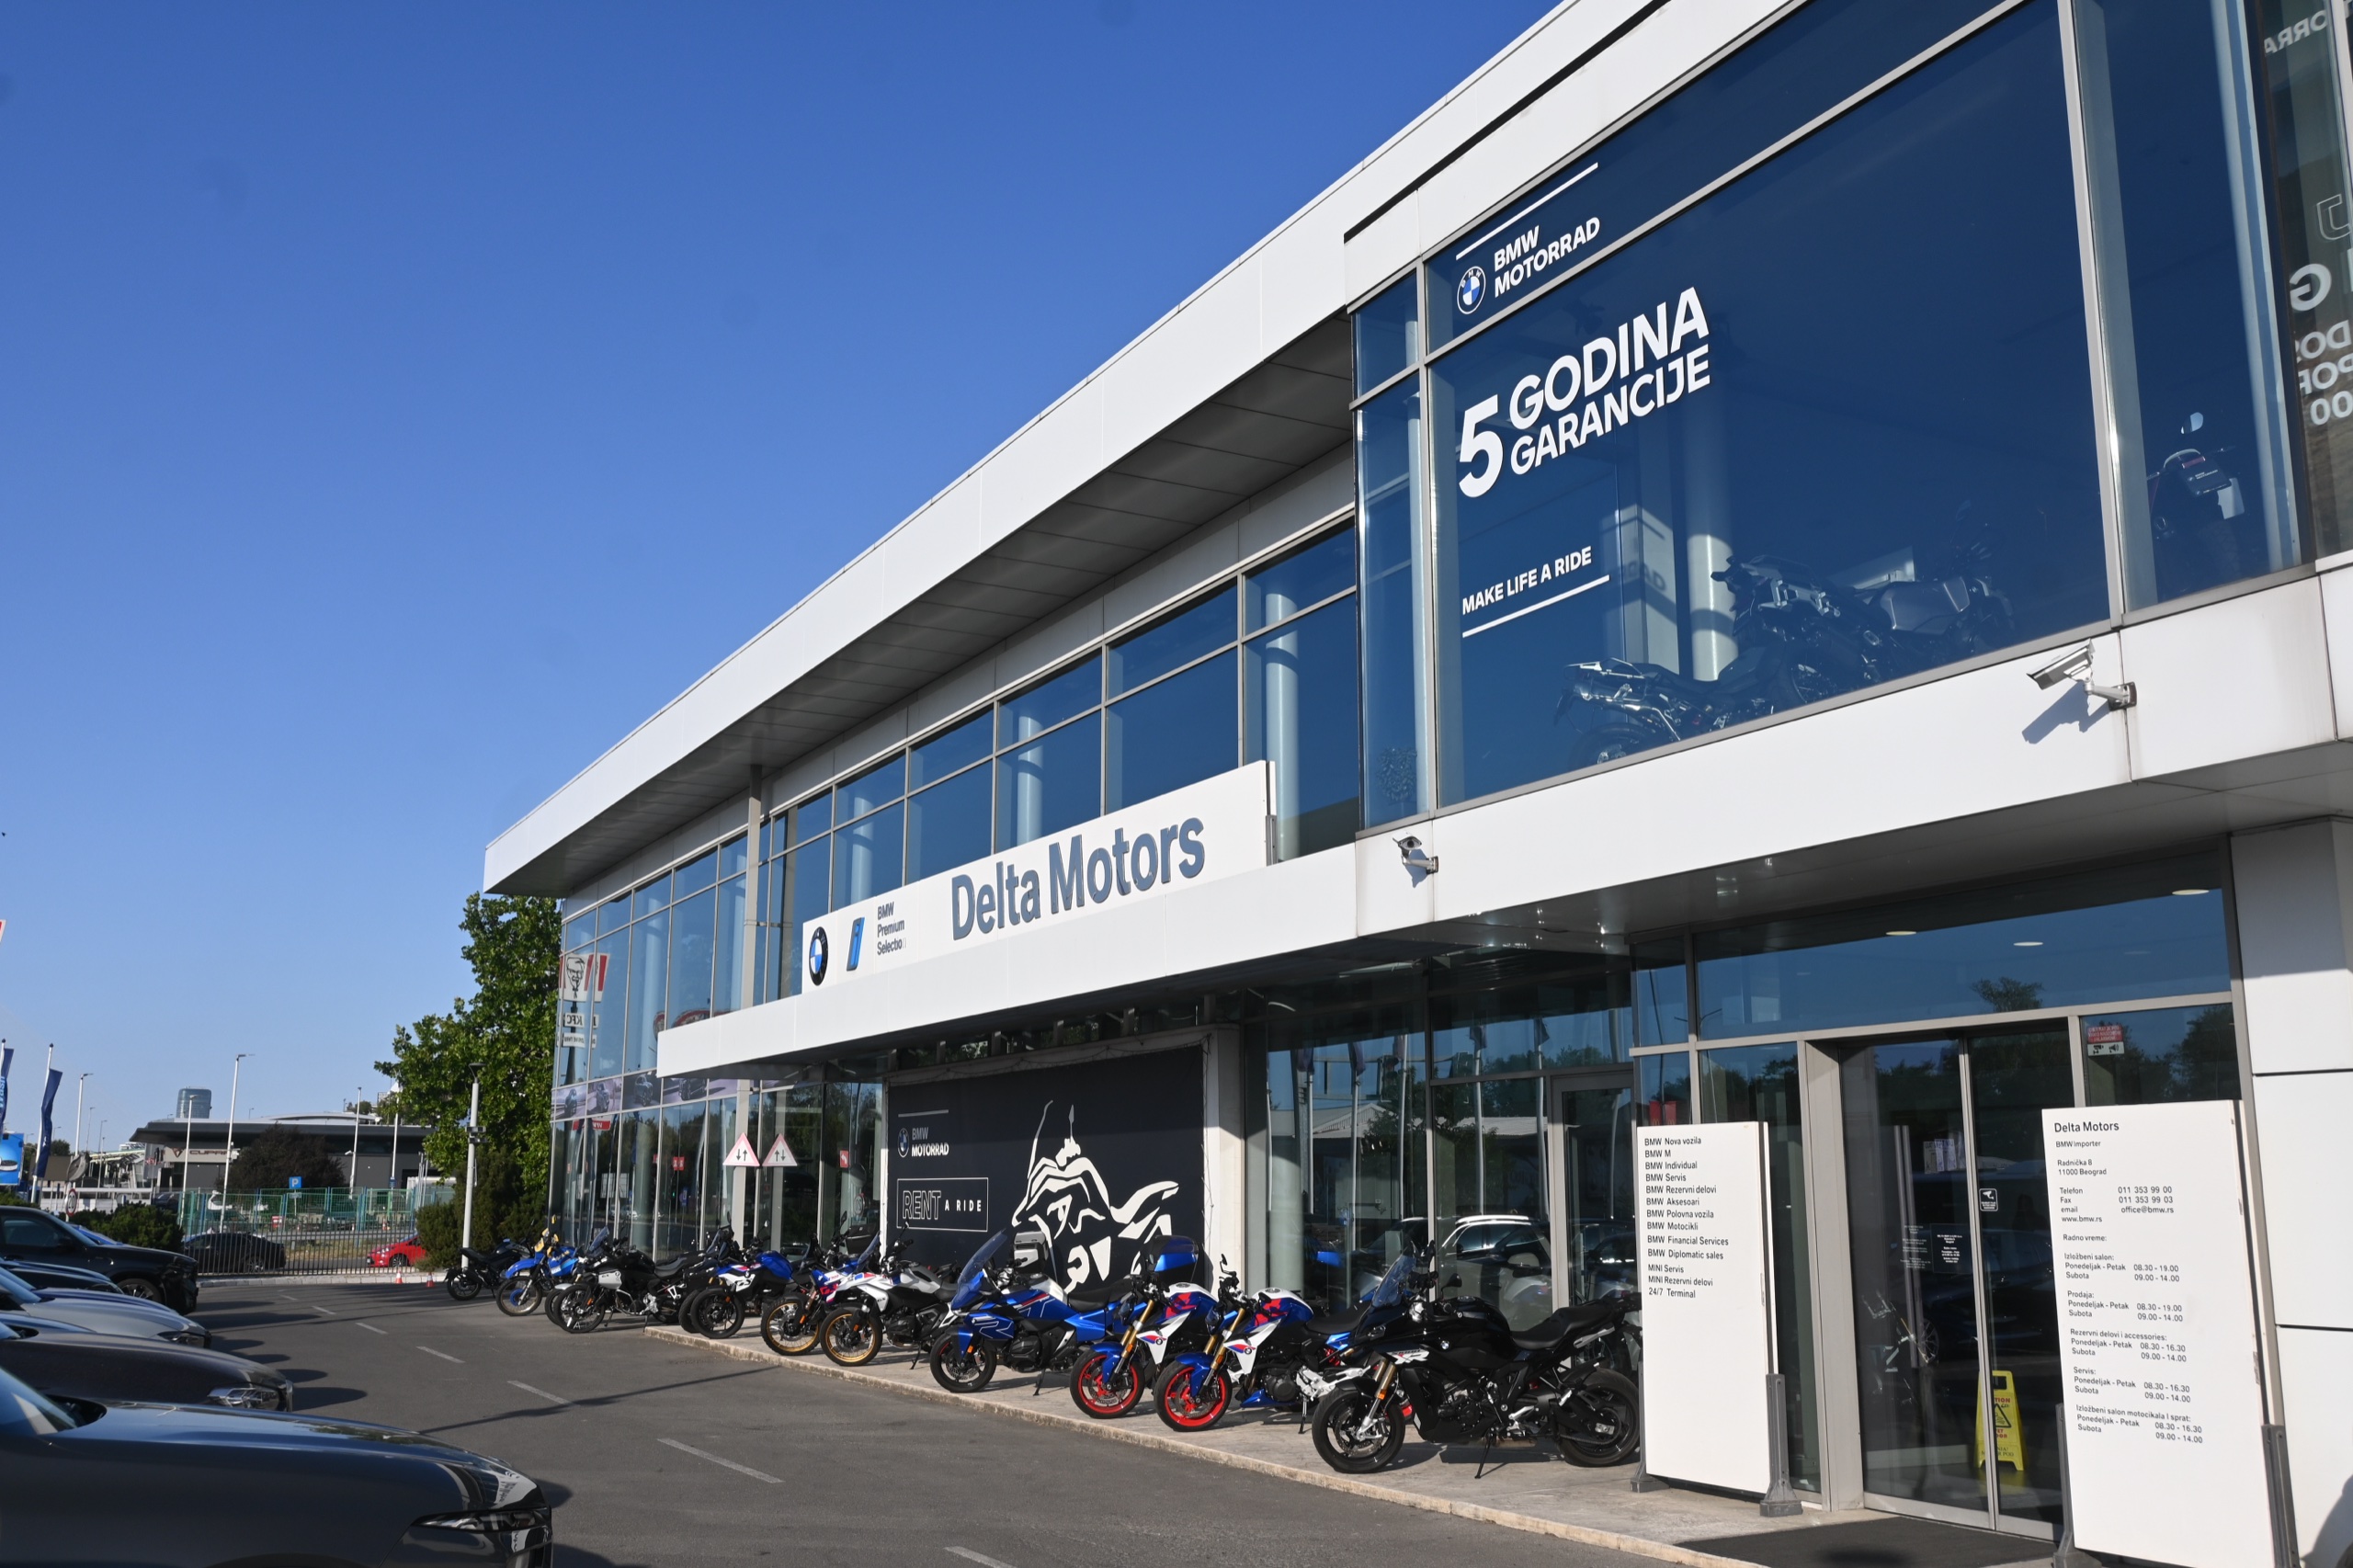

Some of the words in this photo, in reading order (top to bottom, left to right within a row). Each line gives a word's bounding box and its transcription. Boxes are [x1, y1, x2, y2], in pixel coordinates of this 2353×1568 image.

[1494, 224, 1540, 272] BMW
[1495, 217, 1600, 298] MOTORRAD
[1459, 393, 1504, 498] 5
[1509, 286, 1710, 429] GODINA
[1510, 344, 1711, 475] GARANCIJE
[1462, 582, 1504, 615] MAKE
[1506, 568, 1538, 597] LIFE
[1540, 563, 1552, 583] A
[1554, 546, 1592, 576] RIDE
[951, 861, 1040, 941] Delta
[1049, 817, 1206, 915] Motors
[877, 901, 895, 921] BMW
[877, 919, 905, 938] Premium
[2054, 1122, 2080, 1132] Delta
[2083, 1121, 2119, 1131] Motors
[912, 1127, 929, 1141] BMW
[1644, 1138, 1662, 1146] BMW
[911, 1142, 949, 1157] MOTORRAD
[1645, 1150, 1662, 1158] BMW
[1645, 1162, 1663, 1170] BMW
[292, 1178, 299, 1187] P
[1646, 1174, 1663, 1182] BMW
[1665, 1173, 1686, 1181] Servis
[1646, 1186, 1664, 1194] BMW
[1666, 1186, 1694, 1194] Rezervni
[903, 1190, 941, 1220] RENT
[944, 1199, 949, 1211] A
[956, 1199, 982, 1212] RIDE
[1667, 1210, 1693, 1218] Polovna
[1668, 1236, 1698, 1244] Financial
[1699, 1236, 1728, 1245] Services
[1648, 1248, 1665, 1256] BMW
[1668, 1249, 1704, 1259] Diplomatic
[1706, 1251, 1723, 1259] sales
[1665, 1265, 1684, 1273] Servis
[2065, 1262, 2101, 1270] Ponedeljak
[1665, 1276, 1691, 1285] Rezervni
[1649, 1287, 1663, 1295] 24/7
[1666, 1289, 1695, 1298] Terminal
[2068, 1300, 2104, 1309] Ponedeljak
[2072, 1338, 2107, 1347] Ponedeljak
[2142, 1352, 2160, 1360] 09.00
[2075, 1376, 2110, 1386] Ponedeljak
[2170, 1384, 2189, 1392] 16.30
[2075, 1385, 2098, 1393] Subota
[2171, 1394, 2190, 1403] 14.00
[2077, 1415, 2114, 1425] Ponedeljak
[2120, 1418, 2139, 1426] Petak
[2155, 1422, 2175, 1430] 08.30
[2078, 1424, 2101, 1432] Subota
[2156, 1432, 2176, 1440] 09.00
